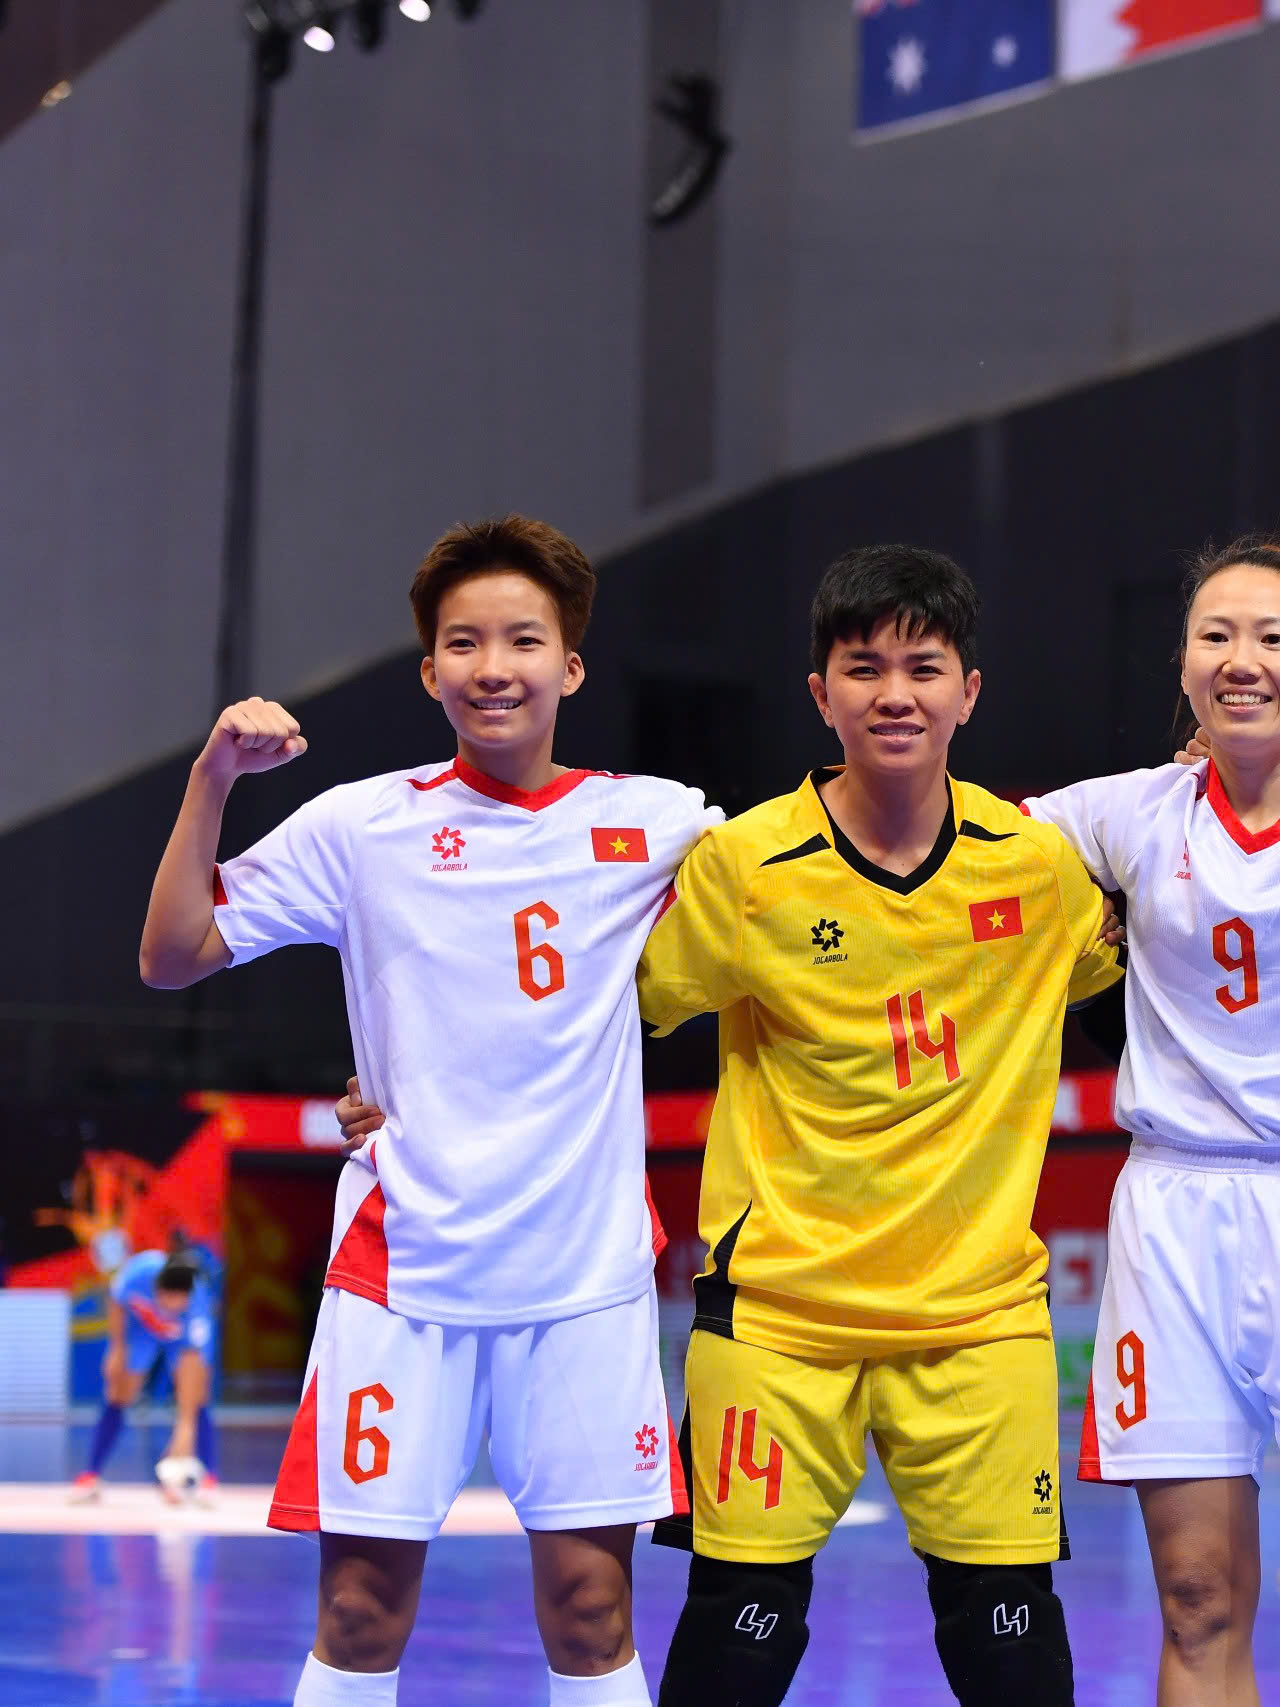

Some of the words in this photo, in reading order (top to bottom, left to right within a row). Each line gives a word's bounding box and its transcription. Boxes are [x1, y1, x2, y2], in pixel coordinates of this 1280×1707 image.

[513, 900, 565, 1002] 6
[1212, 916, 1259, 1015] 9
[886, 988, 961, 1091] 14
[1115, 1330, 1147, 1431] 9
[343, 1382, 394, 1485] 6
[716, 1405, 784, 1511] 14
